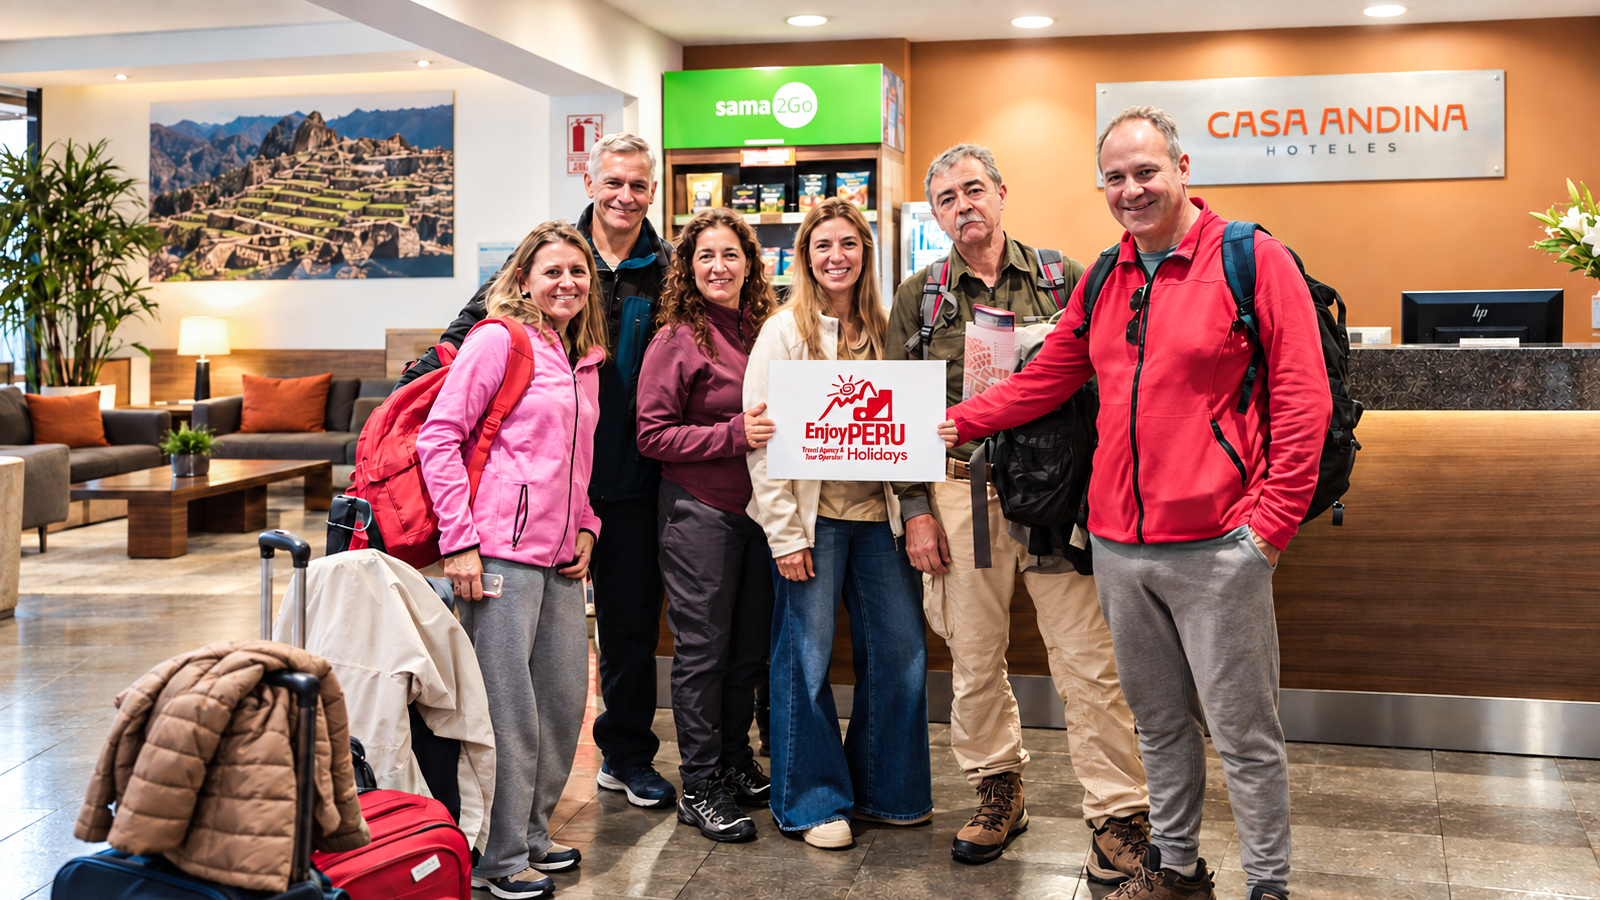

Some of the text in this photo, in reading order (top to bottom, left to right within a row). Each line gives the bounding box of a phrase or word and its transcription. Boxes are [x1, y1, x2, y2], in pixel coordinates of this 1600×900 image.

[715, 97, 813, 117] sama 2Go
[1207, 103, 1469, 138] CASA ANDINA
[1266, 142, 1397, 156] HOTELES
[1472, 304, 1488, 322] hp
[847, 447, 908, 465] Holidays
